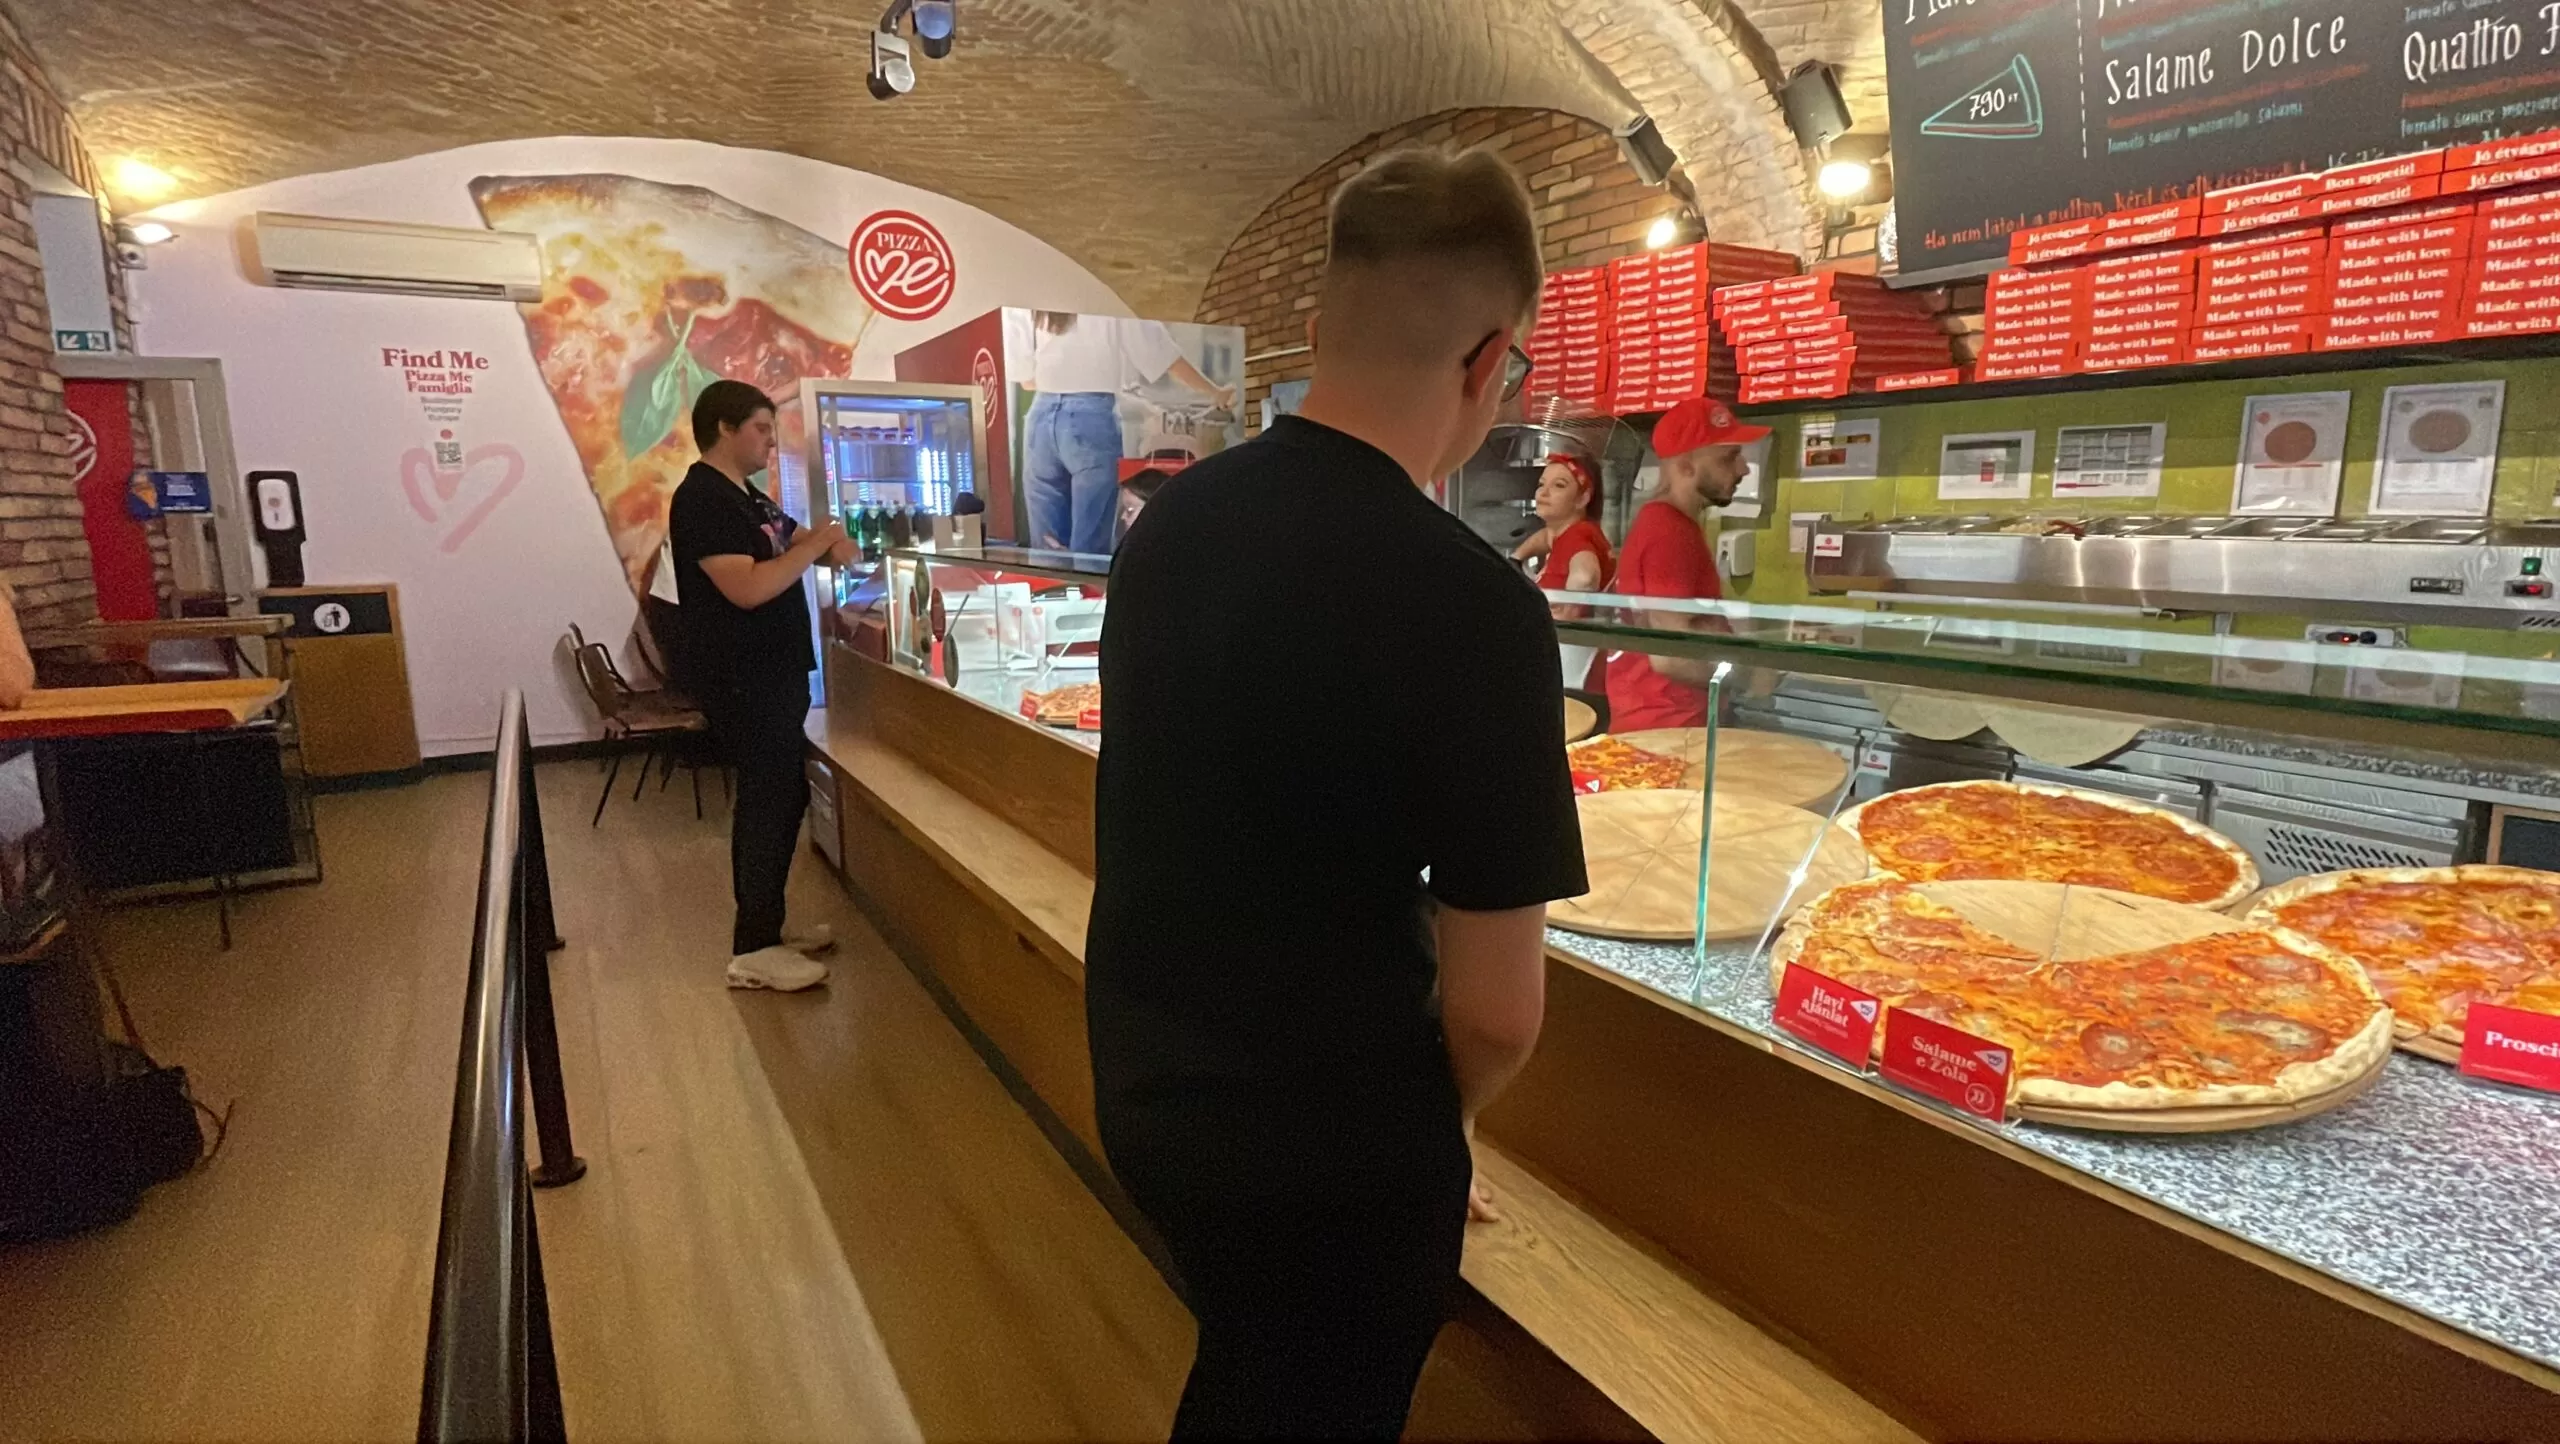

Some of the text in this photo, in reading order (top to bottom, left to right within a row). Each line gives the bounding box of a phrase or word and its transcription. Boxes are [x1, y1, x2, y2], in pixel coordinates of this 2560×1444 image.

[2403, 16, 2522, 84] Quattro
[2105, 47, 2215, 105] Salame
[2239, 16, 2347, 74] Dolce
[1968, 88, 2005, 120] 790
[2471, 149, 2491, 167] Jó
[2325, 162, 2415, 190] Bon appetit!
[2466, 172, 2487, 191] Jó
[2225, 199, 2240, 213] Jó
[2322, 185, 2412, 213] Bon appetit!
[2107, 218, 2132, 230] Bon
[2221, 218, 2237, 233] Jó
[2490, 214, 2536, 230] Made
[876, 231, 933, 252] PIZZA
[2105, 236, 2129, 248] Bon
[2344, 227, 2455, 251] Made with love
[2487, 236, 2532, 252] Made
[2212, 246, 2311, 270] Made with love
[2340, 247, 2452, 270] Made with love
[2485, 257, 2531, 272] Made
[2095, 264, 2180, 285] Made with love
[2212, 265, 2309, 287] Made with love
[2338, 268, 2448, 290] Made with love
[1996, 282, 2071, 300] Made with love
[2094, 283, 2180, 302] Made with love
[2480, 278, 2525, 292] Made
[2210, 284, 2308, 306] Made with love
[2334, 289, 2444, 309] Made with love
[1996, 298, 2071, 316] Made with love
[2094, 301, 2180, 319] Made with love
[2206, 304, 2304, 324] Made with love
[2476, 299, 2521, 314] Made
[1995, 315, 2071, 331] Made with love
[2092, 319, 2178, 336] Made with love
[2330, 310, 2440, 328] Made with love
[2467, 316, 2552, 334] Made with
[1994, 332, 2070, 346] Made with love
[2203, 323, 2300, 341] Made with love
[2325, 329, 2434, 347] Made with love
[2090, 336, 2175, 353] Made with love
[2195, 342, 2292, 360] Made with love
[381, 348, 490, 370] Find Me
[1988, 348, 2063, 362] Made with love
[2084, 354, 2168, 369] Made with love
[405, 369, 473, 383] Pizza Me
[1986, 364, 2061, 378] Made with love
[407, 381, 473, 395] Famiglia
[2485, 1030, 2560, 1058] Prosci
[1911, 1035, 1977, 1072] Salame
[1915, 1056, 1926, 1068] e
[1930, 1057, 1969, 1084] Zola
